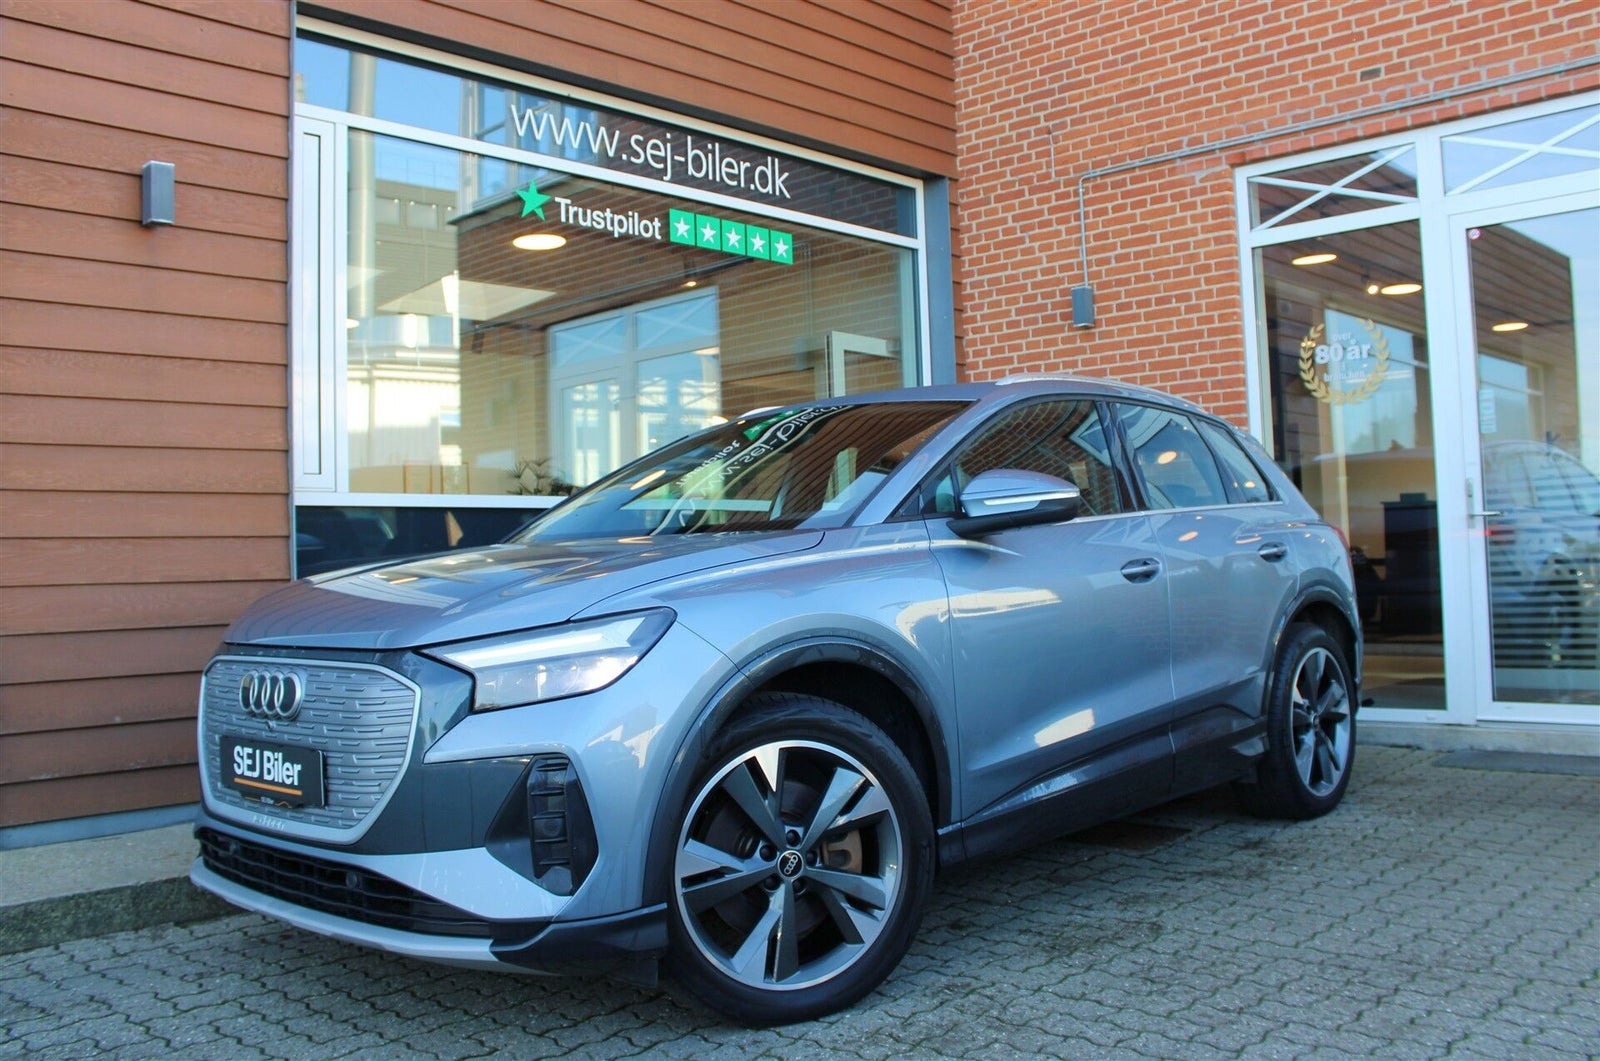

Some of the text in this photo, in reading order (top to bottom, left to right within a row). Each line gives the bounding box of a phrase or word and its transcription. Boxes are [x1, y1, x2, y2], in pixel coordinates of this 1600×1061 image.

[511, 104, 791, 198] www.sej-biler.dk
[554, 197, 661, 239] Trustpilot
[1315, 338, 1371, 364] 80 år
[234, 746, 301, 785] SEJ Biler
